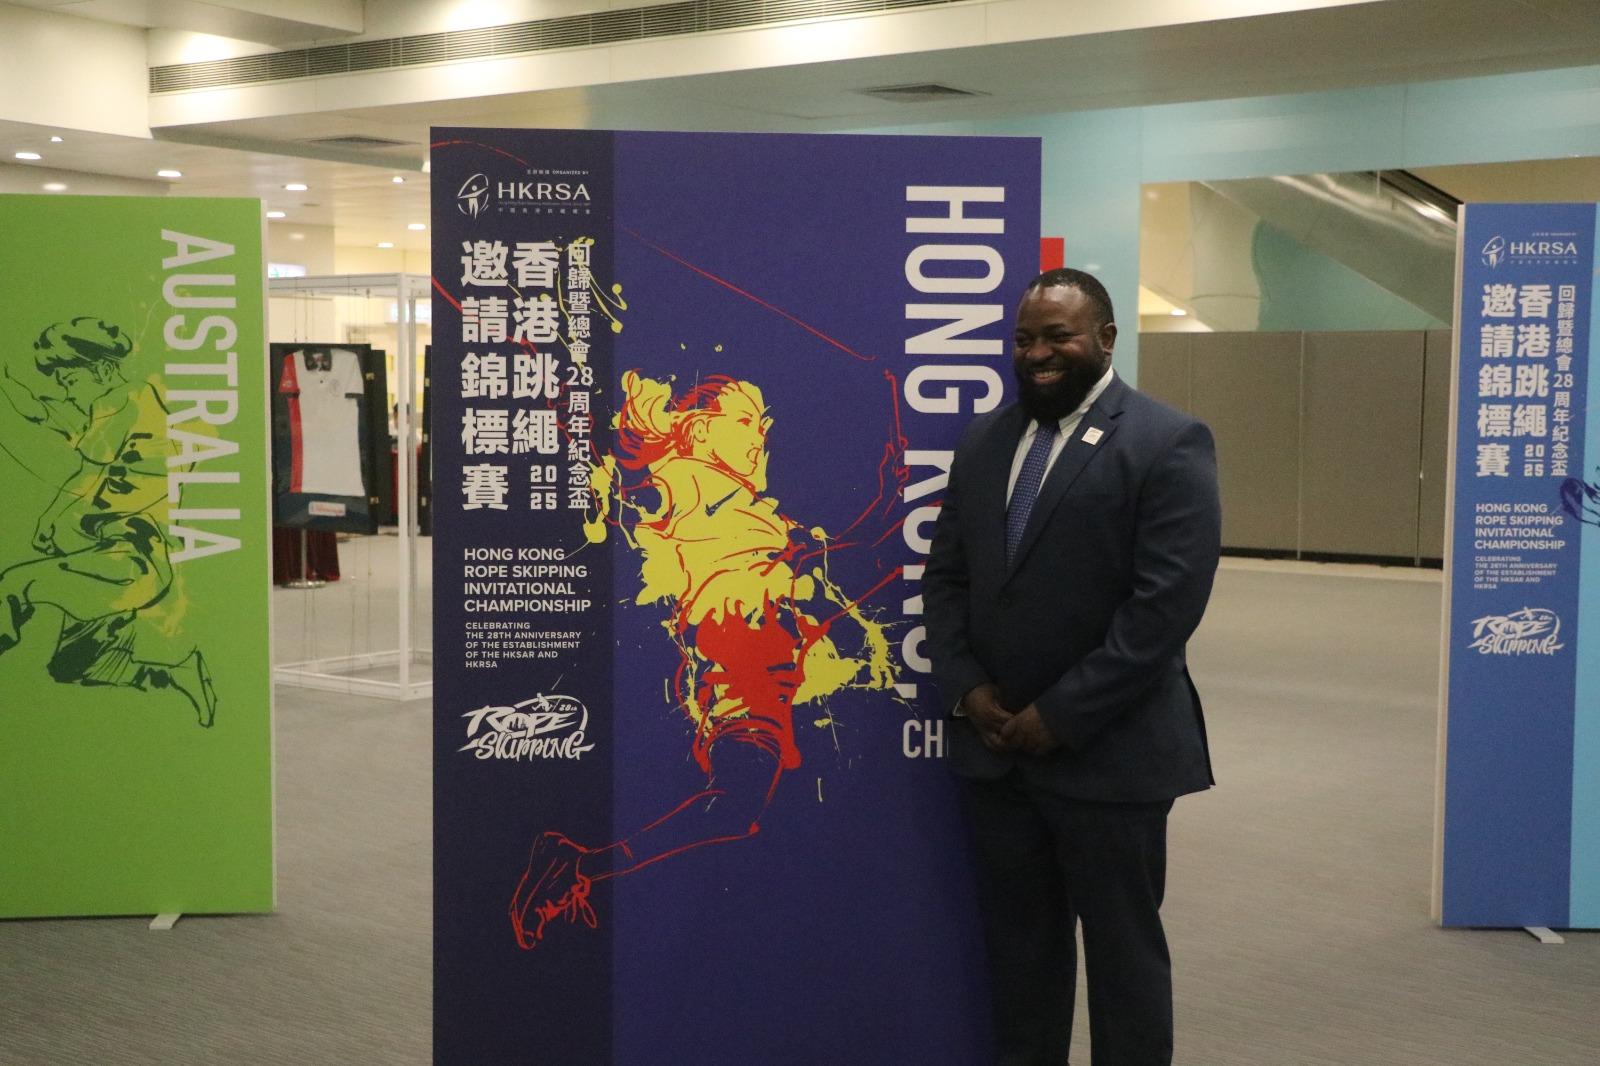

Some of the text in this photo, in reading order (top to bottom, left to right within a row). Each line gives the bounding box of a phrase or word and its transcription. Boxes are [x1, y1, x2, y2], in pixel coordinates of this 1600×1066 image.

[498, 182, 591, 200] HKRSA
[1510, 242, 1577, 255] HKRSA
[904, 185, 1006, 416] HONG
[511, 240, 560, 456] 香港跳繩
[1513, 284, 1552, 437] 香港跳繩
[460, 239, 509, 511] 邀請錦標賽
[1476, 284, 1517, 478] 邀請錦標賽
[161, 228, 242, 563] AUSTRALIA
[1524, 443, 1545, 458] 20
[530, 465, 557, 483] 20
[530, 493, 557, 510] 25
[1476, 503, 1548, 513] HONG KONG
[1475, 516, 1564, 525] ROPE SKIPPING
[1475, 528, 1554, 537] INVITATIONAL
[1474, 540, 1565, 549] CHAMPIONSHIP
[464, 548, 565, 561] HONG KONG
[464, 565, 588, 578] ROPE SKIPPING
[464, 582, 576, 595] INVITATIONAL
[464, 600, 592, 612] CHAMPIONSHIP
[1471, 615, 1552, 638] ROPE
[461, 705, 577, 737] ROPE
[902, 719, 949, 759] CH
